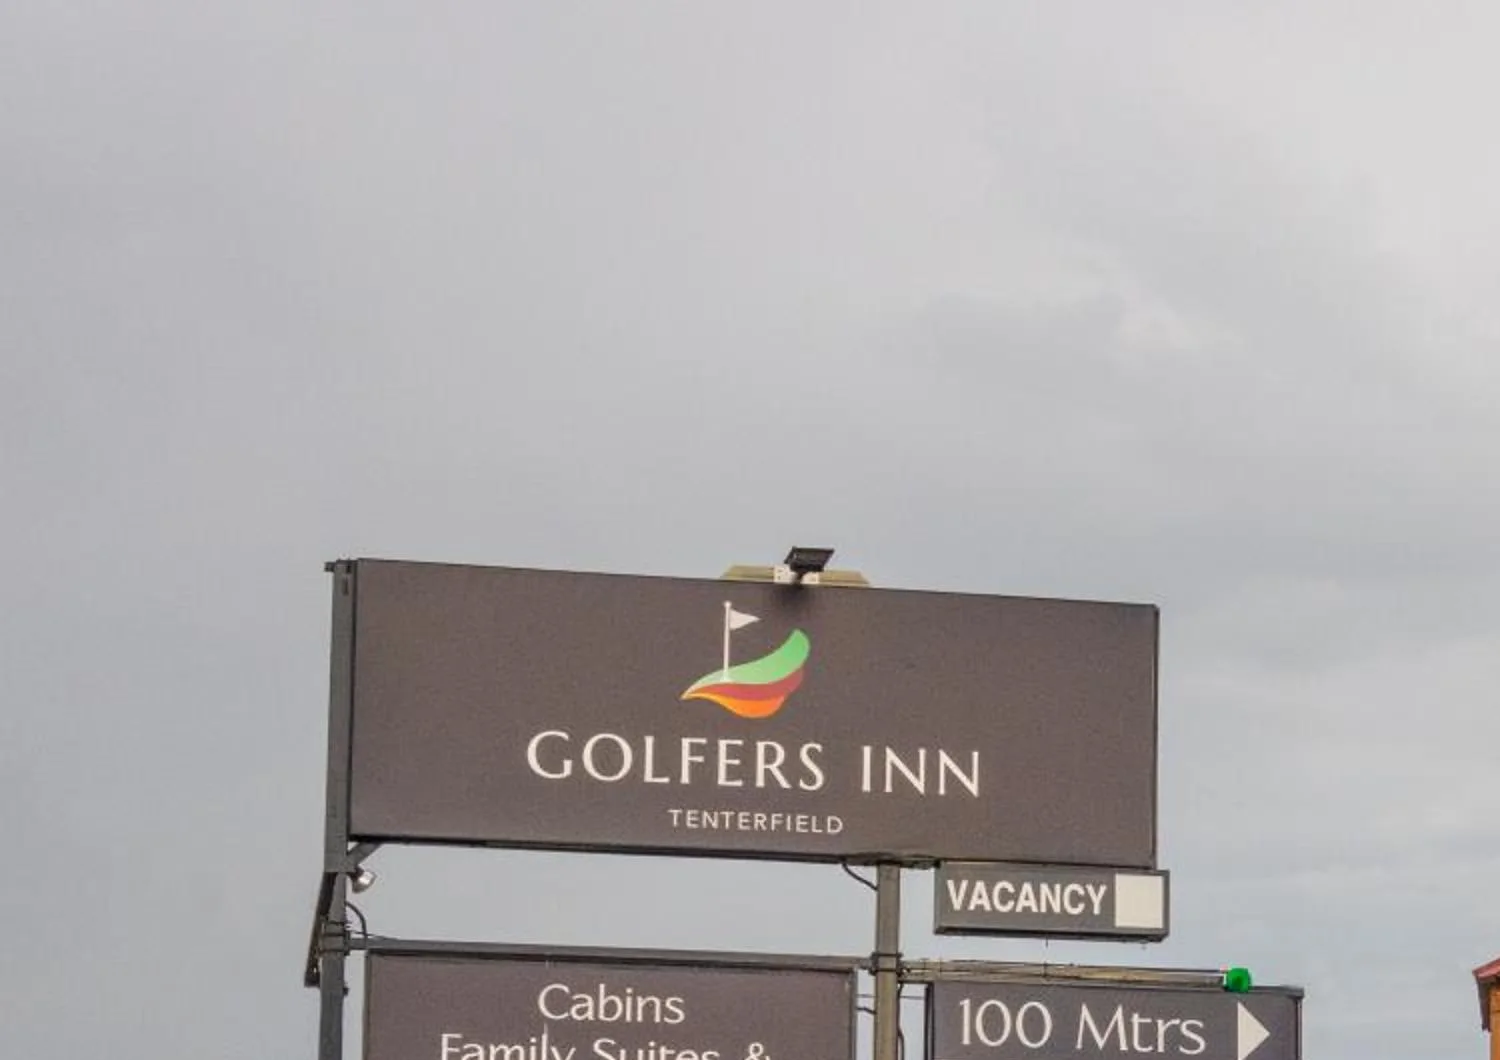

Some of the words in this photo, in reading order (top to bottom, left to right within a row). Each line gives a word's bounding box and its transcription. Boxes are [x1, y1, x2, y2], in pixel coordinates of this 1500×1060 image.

[526, 729, 825, 791] GOLFERS
[862, 744, 980, 797] INN
[668, 808, 844, 835] TENTERFIELD
[946, 879, 1107, 915] VACANCY
[538, 982, 686, 1024] Cabins
[958, 998, 1053, 1049] 100
[1075, 1002, 1207, 1056] Mtrs
